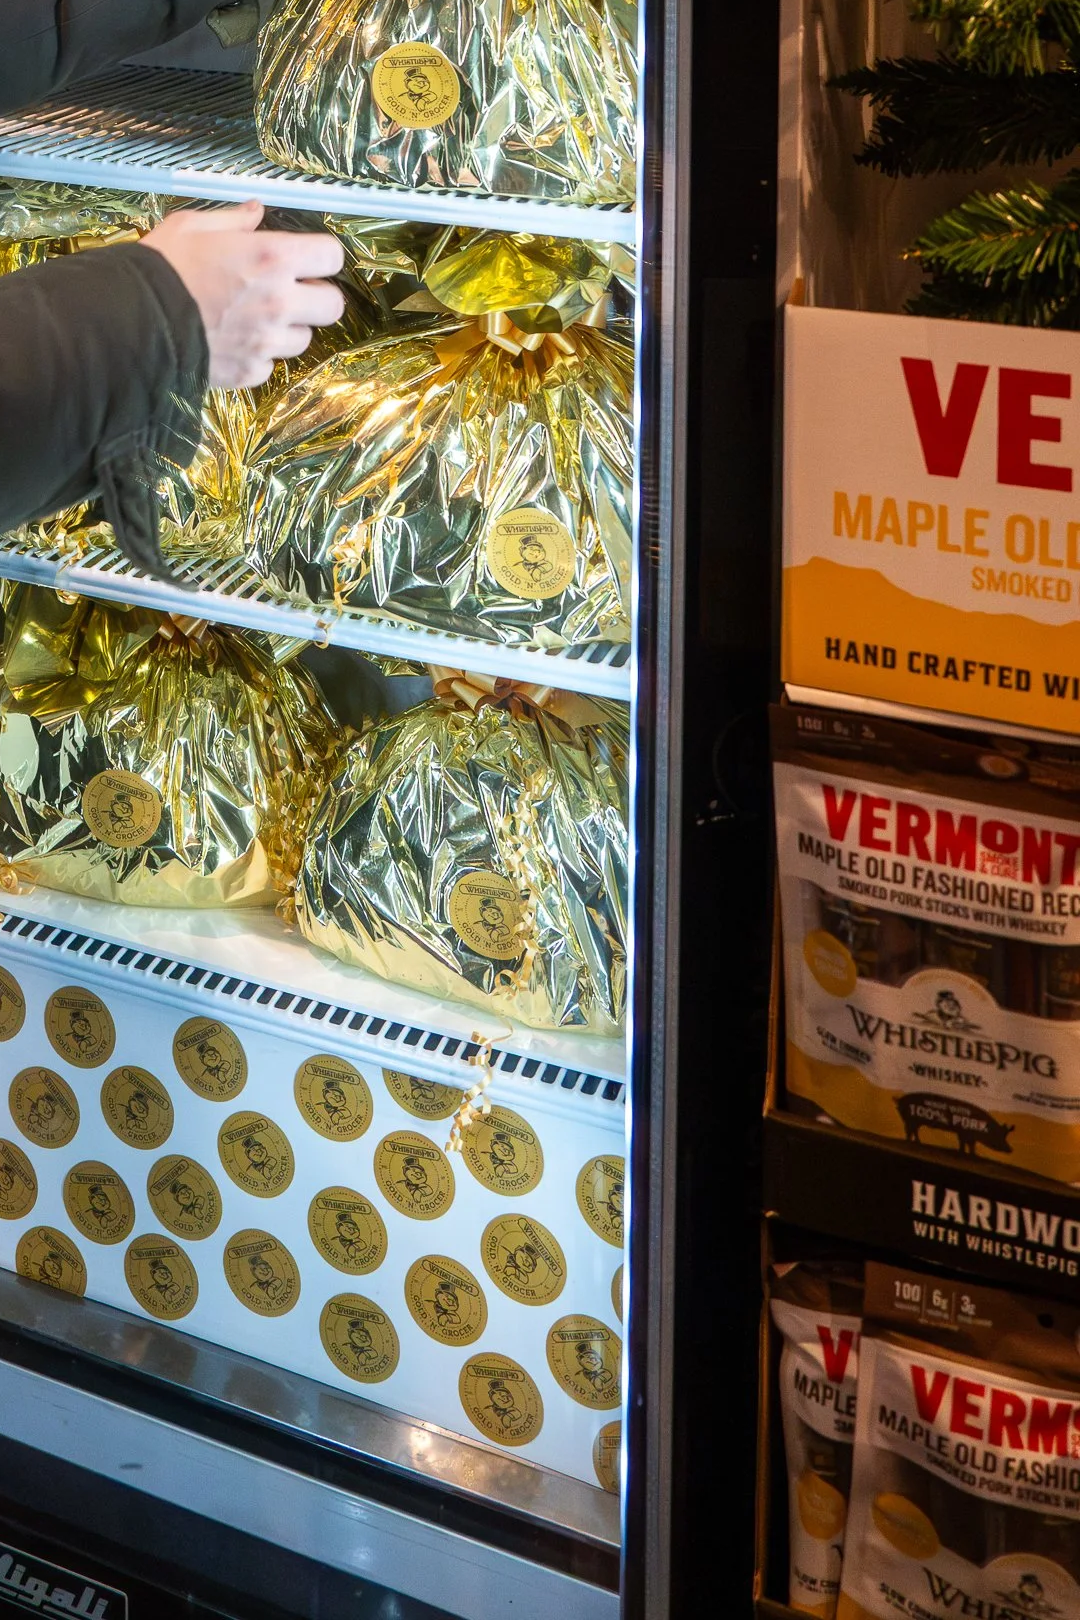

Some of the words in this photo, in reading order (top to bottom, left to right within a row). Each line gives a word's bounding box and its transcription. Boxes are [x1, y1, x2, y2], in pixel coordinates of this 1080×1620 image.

[386, 96, 407, 115] GOLD
[424, 94, 450, 118] GROCER
[901, 356, 1073, 493] VE
[833, 490, 990, 558] MAPLE
[501, 565, 520, 585] GOLD
[540, 565, 565, 589] GROCER
[971, 566, 1071, 604] SMOKED
[825, 637, 897, 670] HAND
[908, 651, 1031, 692] CRAFTED
[1043, 672, 1080, 701] WI
[91, 807, 102, 828] GOLD
[116, 826, 146, 840] GROCER
[822, 784, 1080, 886] VERMONT
[798, 832, 859, 875] MAPLE
[865, 856, 906, 886] OLD
[912, 867, 1035, 914] FASHIONED
[837, 875, 888, 901] SMOKED
[890, 887, 923, 909] PORK
[925, 898, 969, 920] STICKS
[972, 908, 1006, 927] WITH
[1008, 915, 1067, 936] WHISKEY
[462, 922, 480, 943] GOLD
[55, 1033, 71, 1053] GOLD
[194, 1077, 214, 1092] GOLD
[227, 1058, 242, 1089] GROCER
[390, 1070, 402, 1090] OLD
[413, 1100, 447, 1112] GROCER
[109, 1097, 118, 1120] GOLD
[127, 1131, 157, 1141] GROCER
[305, 1101, 322, 1123] GOLD
[337, 1114, 364, 1133] GROCER
[909, 1103, 948, 1124] 100%
[952, 1114, 988, 1133] PORK
[238, 1172, 259, 1187] GOLD
[272, 1154, 288, 1185] GROCER
[469, 1147, 485, 1172] GOLD
[499, 1172, 531, 1187] GROCER
[173, 1219, 194, 1232] GOLD
[205, 1191, 215, 1224] GROCER
[386, 1180, 404, 1202] GOLD
[420, 1190, 446, 1211] GROCER
[585, 1196, 600, 1221] GOLD
[75, 1211, 93, 1231] GOLD
[911, 1180, 1080, 1253] HARDWO
[320, 1237, 339, 1259] GOLD
[354, 1244, 379, 1266] GROCER
[913, 1220, 958, 1245] WITH
[966, 1233, 1078, 1276] WHISTLEPIG
[490, 1236, 498, 1259] GOLD
[502, 1276, 536, 1297] GROCER
[139, 1288, 158, 1306] GOLD
[171, 1284, 192, 1310] GROCER
[241, 1287, 262, 1305] GOLD
[276, 1277, 294, 1305] GROCER
[894, 1280, 921, 1302] 100
[413, 1294, 428, 1320] GOLD
[441, 1324, 474, 1337] GROCER
[331, 1342, 349, 1365] GOLD
[363, 1354, 390, 1374] GROCER
[563, 1374, 585, 1396] GOLD
[794, 1368, 857, 1418] MAPLE
[472, 1406, 493, 1429] GOLD
[510, 1413, 535, 1437] GROCER
[910, 1364, 1080, 1456] VERM
[878, 1405, 950, 1457] MAPLE
[954, 1442, 997, 1473] OLD
[926, 1452, 977, 1486] SMOKED
[979, 1477, 1012, 1495] PORK
[1016, 1488, 1060, 1507] STICKS
